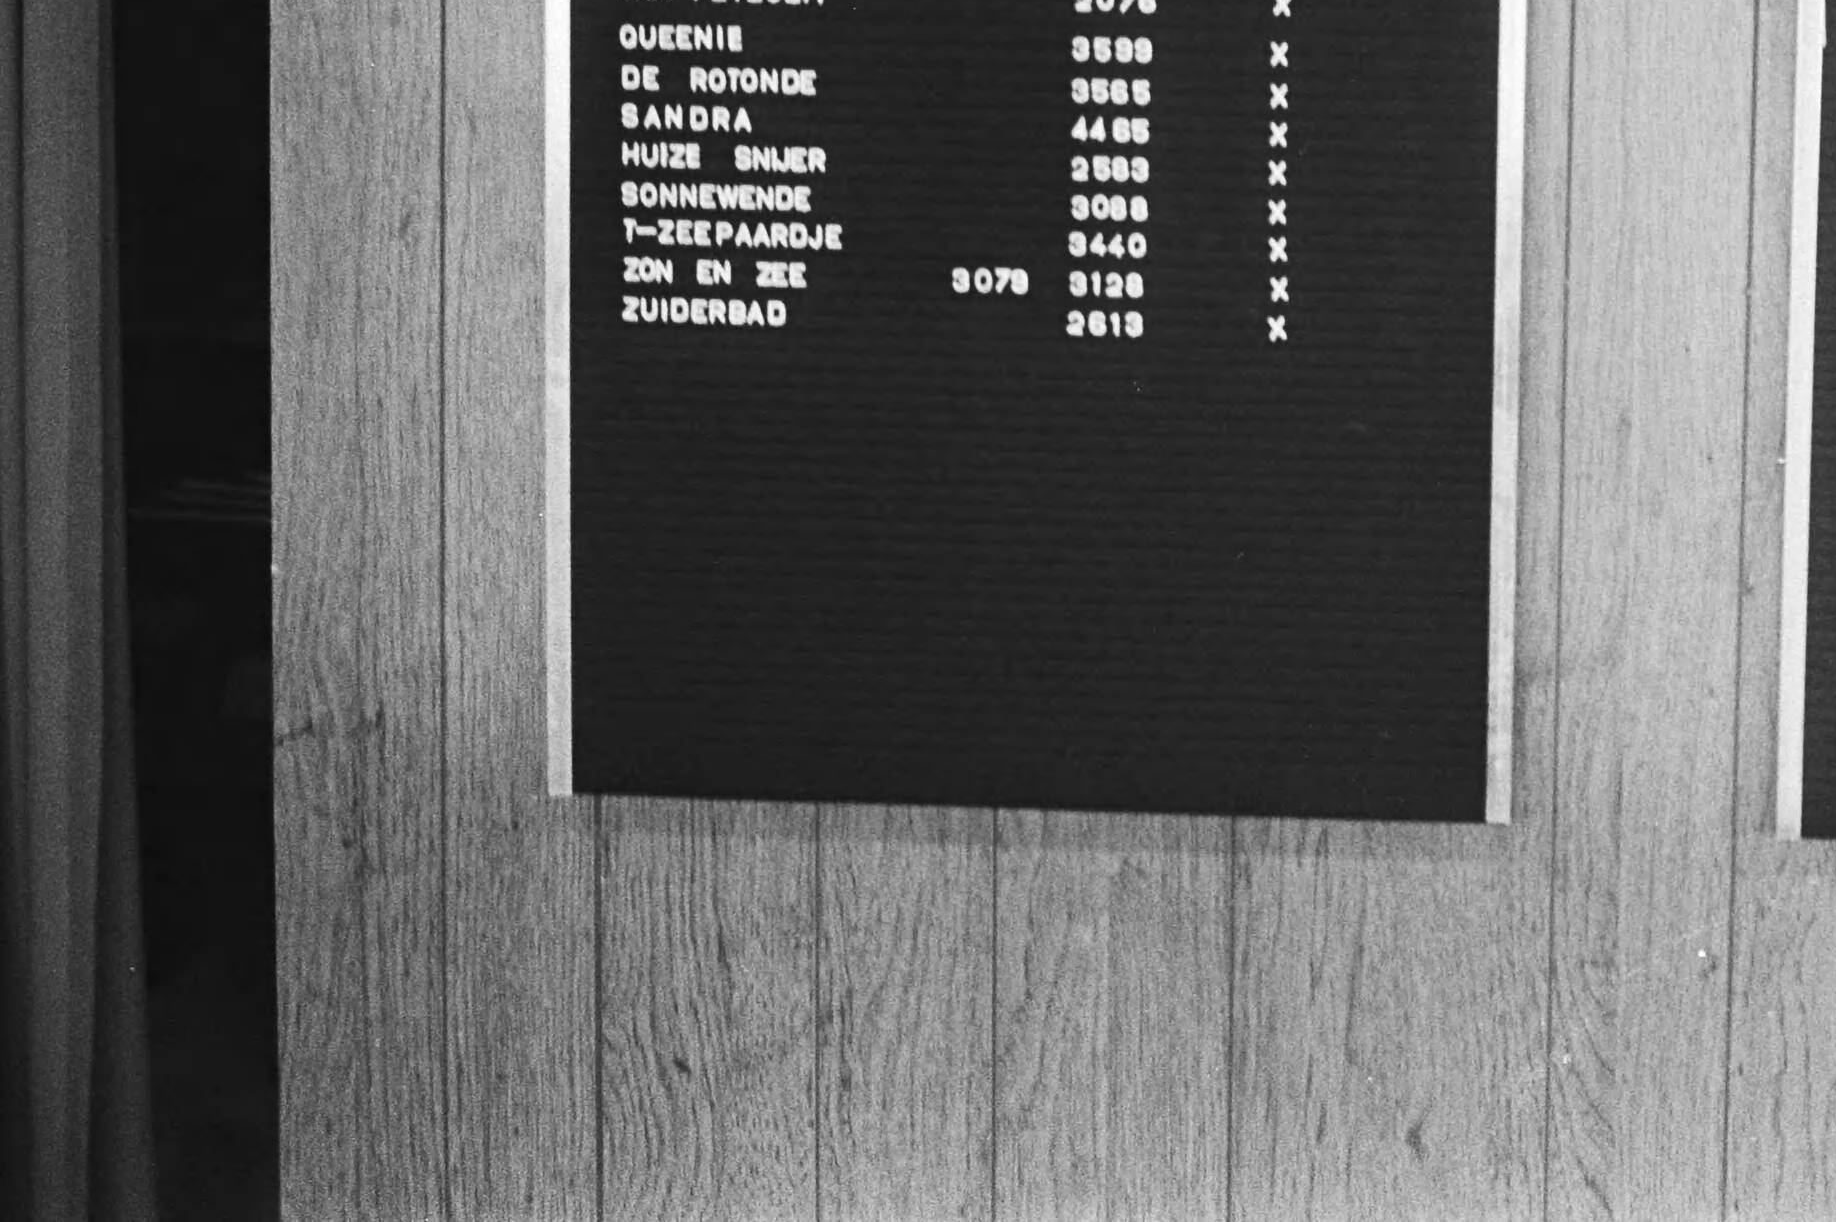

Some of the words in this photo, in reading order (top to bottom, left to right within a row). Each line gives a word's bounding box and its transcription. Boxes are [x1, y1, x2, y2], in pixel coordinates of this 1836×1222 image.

[619, 23, 743, 53] QUEENIE
[621, 64, 660, 92] DE
[689, 66, 817, 97] ROTONDE
[620, 102, 753, 134] SANDRA
[621, 141, 701, 170] HUIZE
[620, 180, 812, 214] SONNEWENDE
[1068, 230, 1148, 260] 3440
[623, 255, 674, 285] ZON
[695, 258, 732, 286] EN
[755, 260, 808, 289] ZEE
[621, 295, 787, 327] ZUIDERBAD
